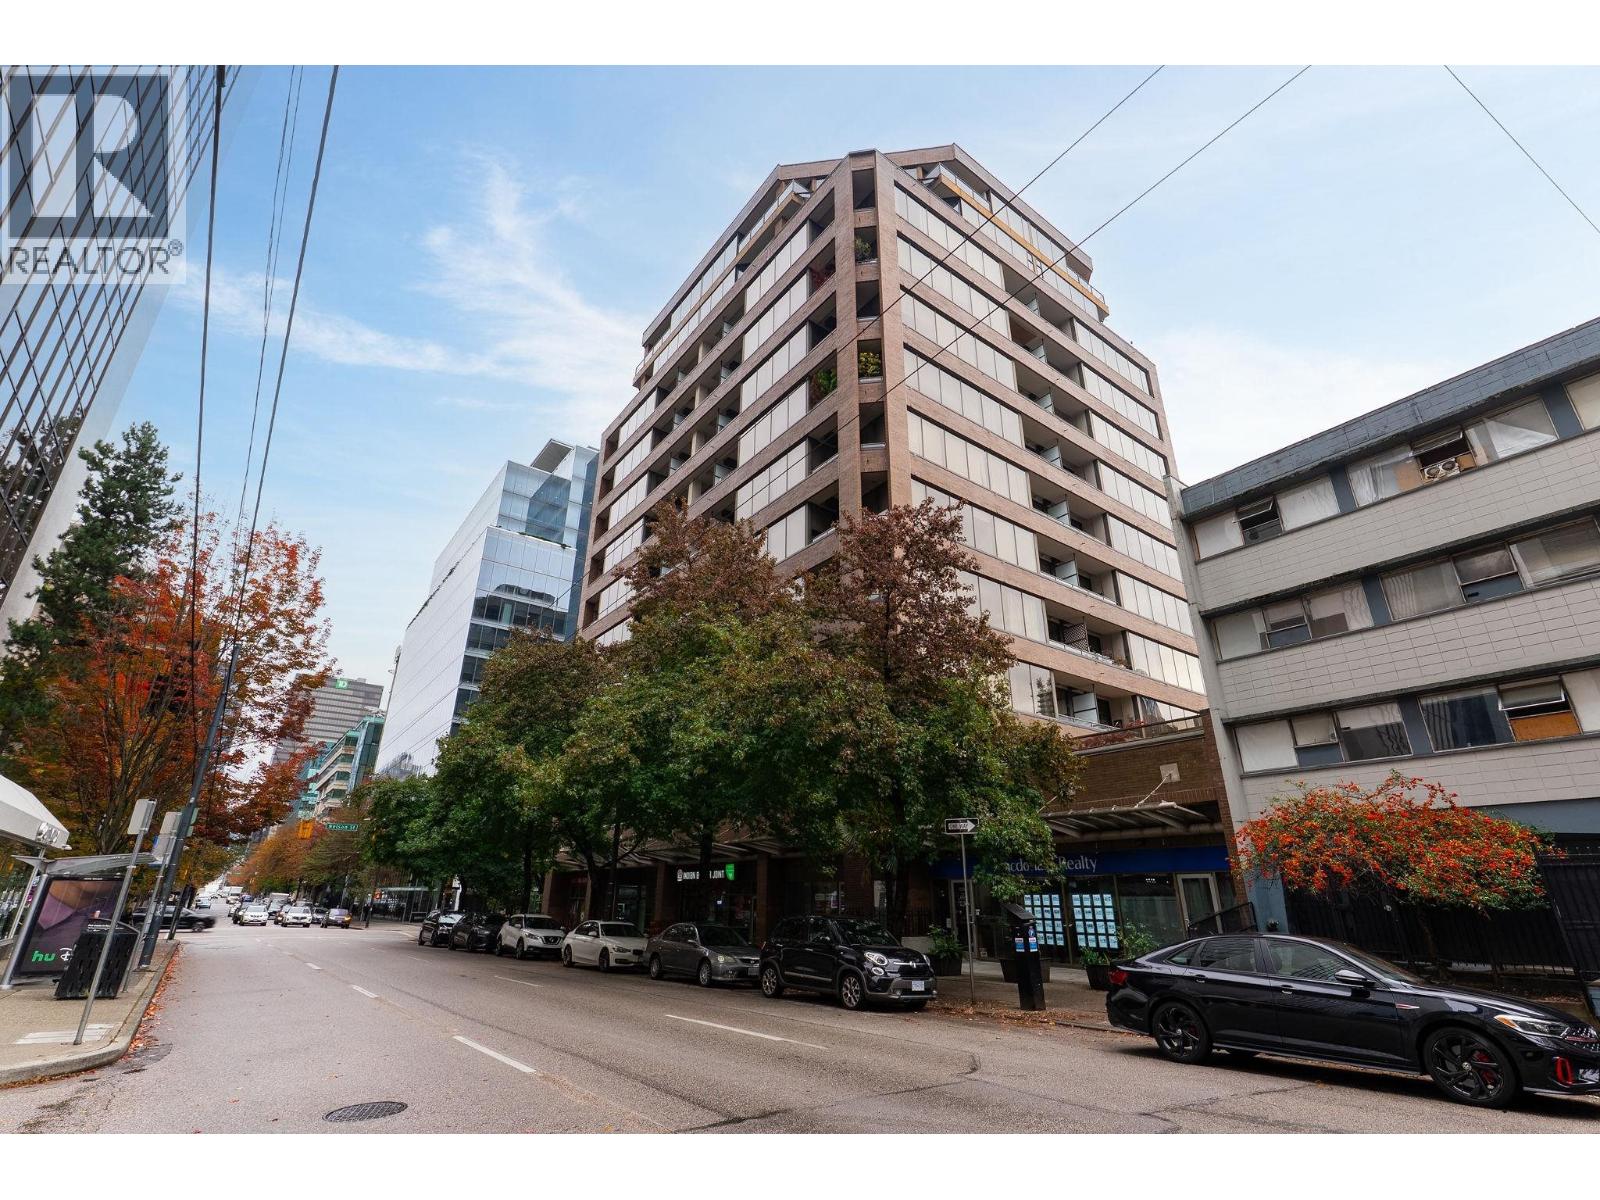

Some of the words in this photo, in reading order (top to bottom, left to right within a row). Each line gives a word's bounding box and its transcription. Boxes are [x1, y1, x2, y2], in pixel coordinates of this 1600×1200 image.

[338, 681, 348, 689] TD
[1058, 855, 1098, 873] Realty
[712, 870, 725, 879] JOINT
